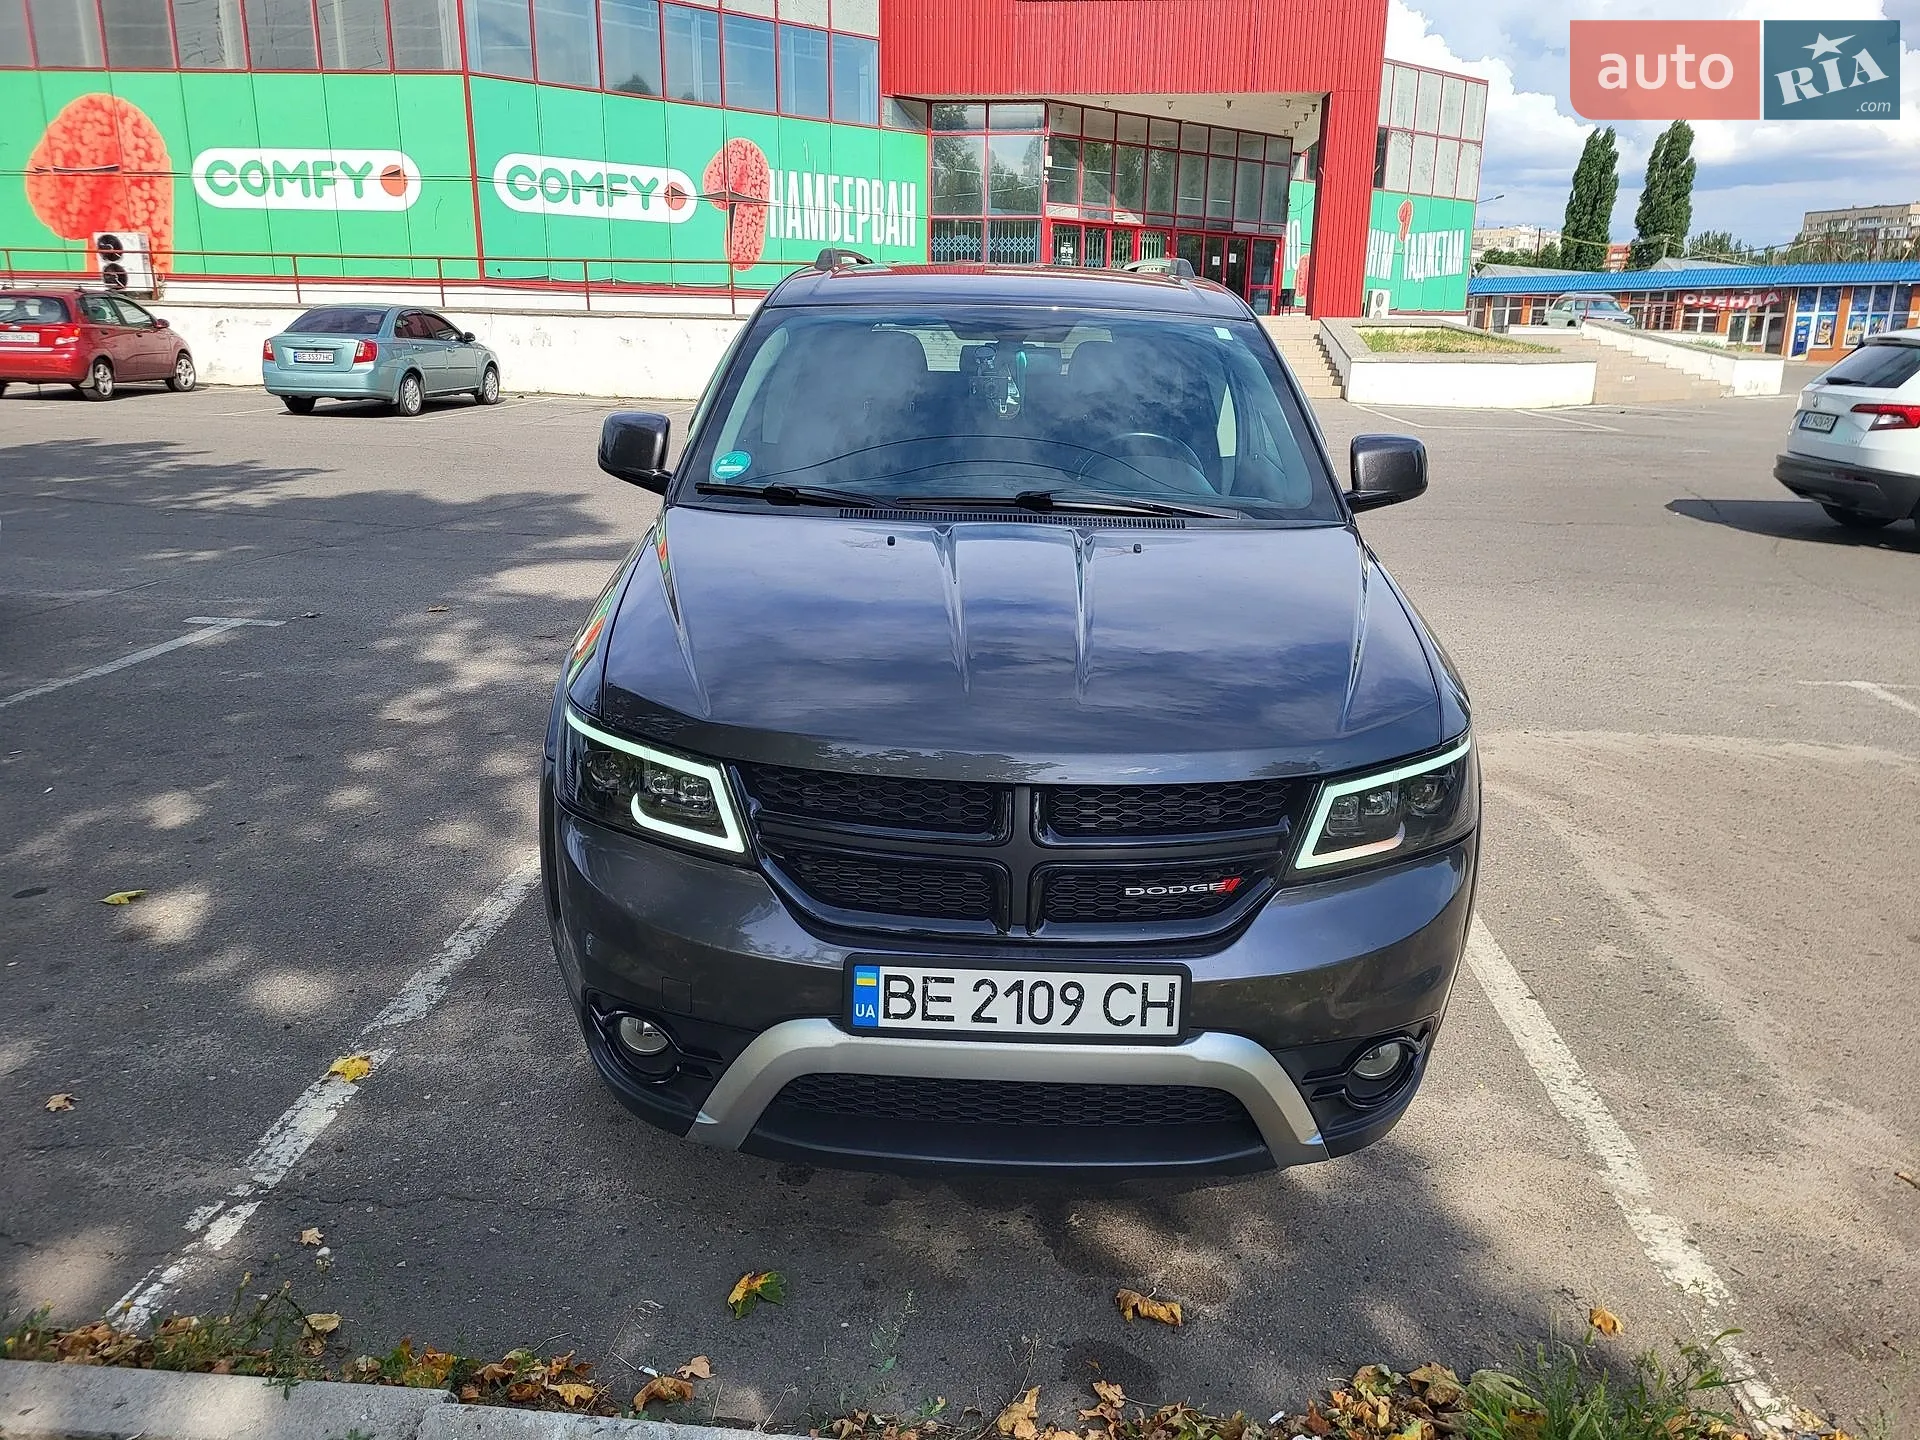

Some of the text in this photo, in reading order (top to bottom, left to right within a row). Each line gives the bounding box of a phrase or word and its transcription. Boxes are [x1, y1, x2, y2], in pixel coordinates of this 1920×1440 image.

[204, 159, 374, 199] COMFY
[506, 164, 659, 211] COMFY
[768, 167, 917, 248] НАМБЕРВАН
[1683, 290, 1780, 307] ОРЕНДА
[1124, 881, 1228, 896] DODGE
[854, 1003, 876, 1019] UA
[882, 973, 1177, 1028] BE 2109 CH
